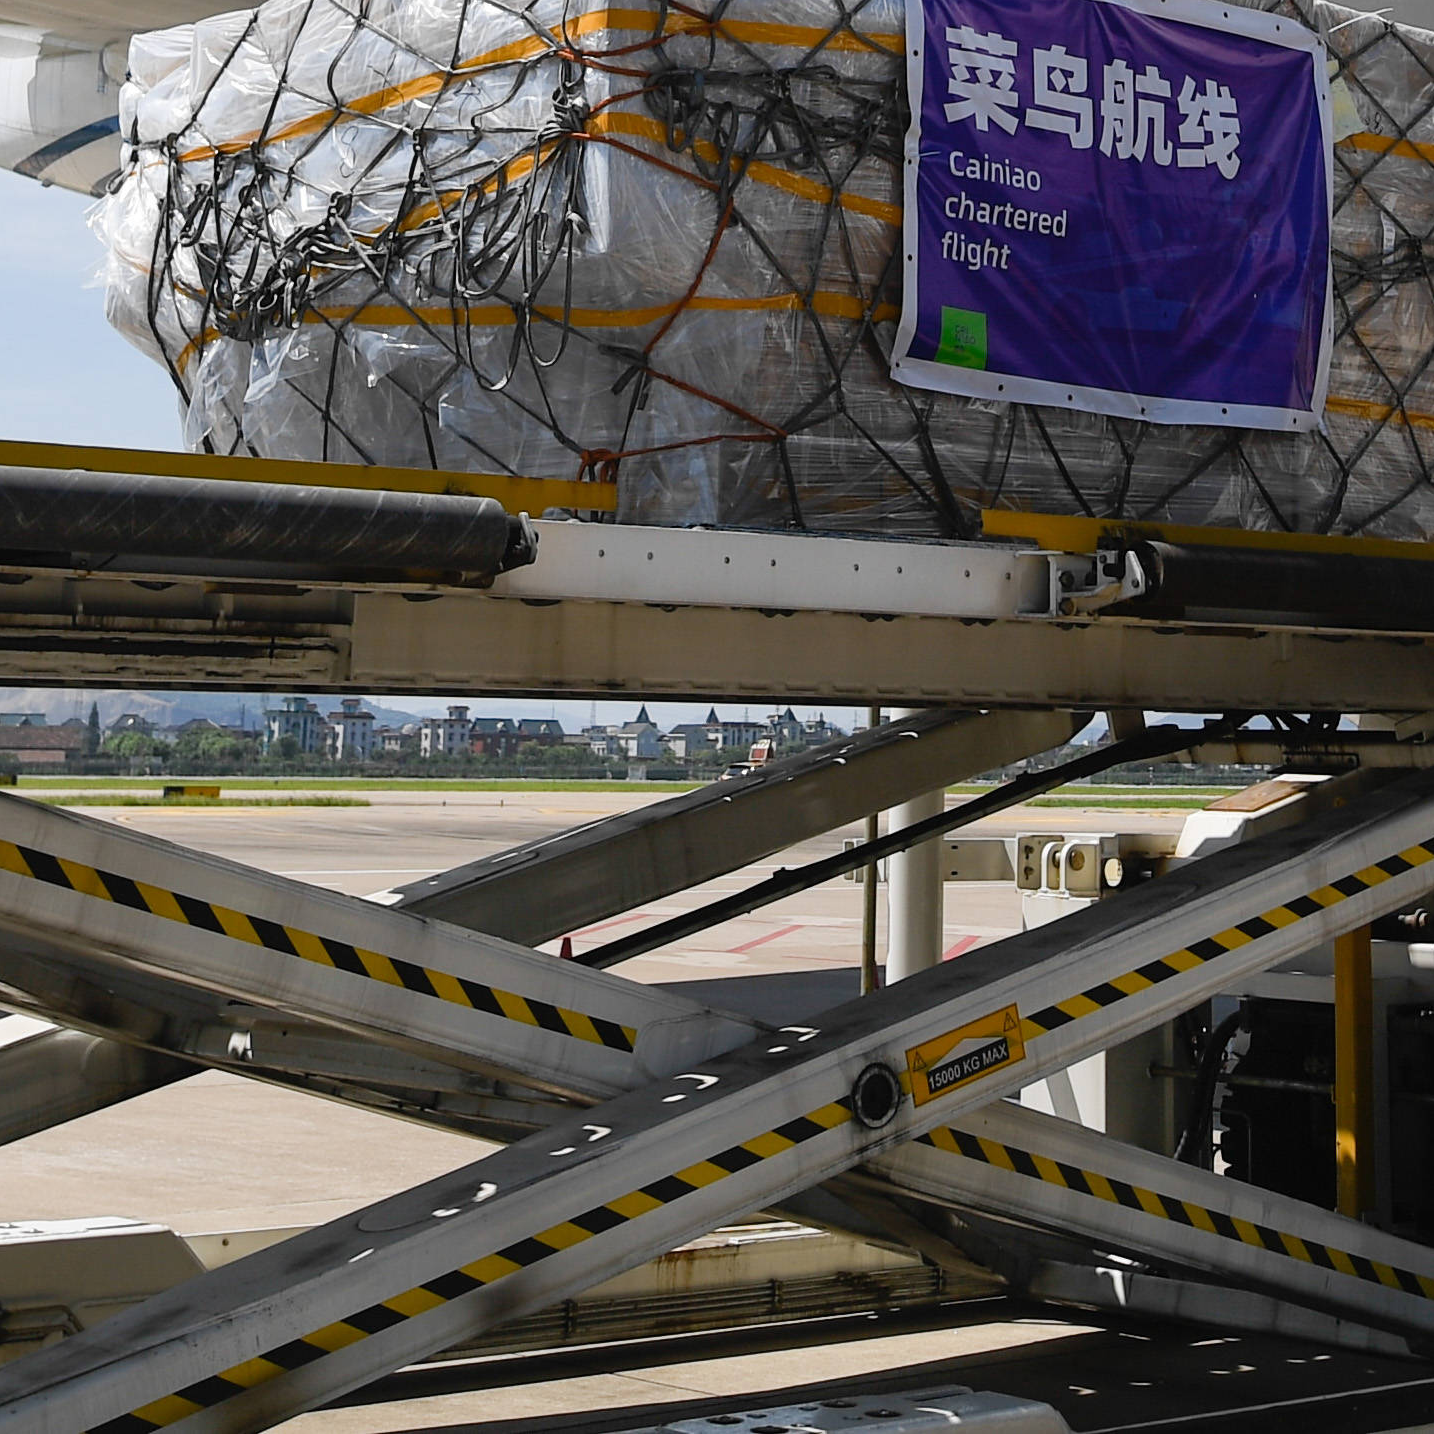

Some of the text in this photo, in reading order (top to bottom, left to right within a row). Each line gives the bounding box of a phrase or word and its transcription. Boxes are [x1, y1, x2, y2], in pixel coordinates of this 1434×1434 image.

[943, 24, 1242, 180] 菜鸟航线
[948, 150, 1042, 192] Cainiao
[944, 192, 1068, 238] chartered
[941, 231, 1011, 270] flight
[929, 1043, 1008, 1090] 15000 KG MAX
